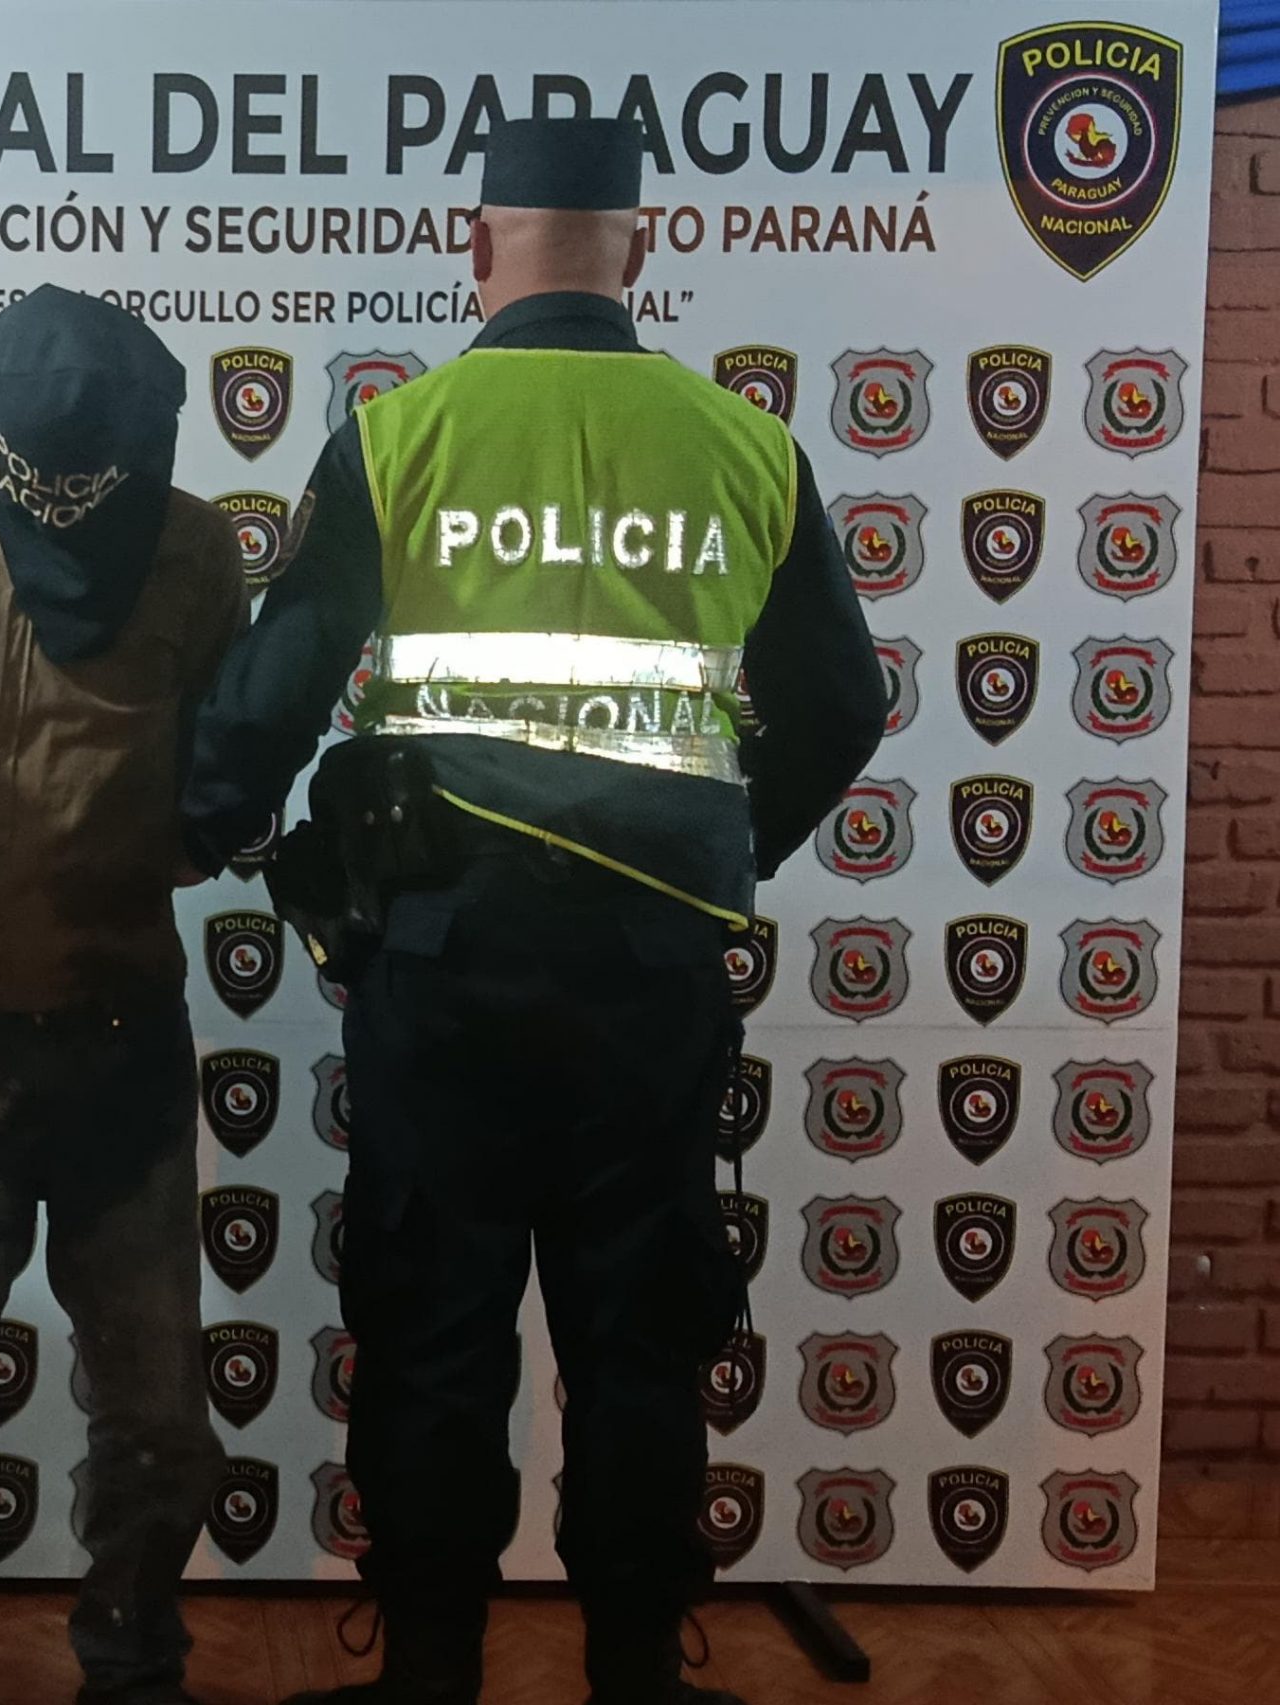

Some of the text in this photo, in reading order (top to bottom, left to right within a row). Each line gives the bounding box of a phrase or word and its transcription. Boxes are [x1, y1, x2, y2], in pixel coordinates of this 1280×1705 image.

[1022, 39, 1163, 82] POLICIA
[1038, 87, 1143, 137] PREVENCION Y SEGURIDAD
[152, 73, 347, 174] DEL
[1051, 177, 1123, 201] PARAGUAY
[141, 206, 170, 252] Y
[185, 206, 472, 255] SEGURIDAD
[723, 190, 936, 252] PARANÁ
[1040, 214, 1133, 235] NACIONAL
[272, 291, 336, 323] SER
[348, 281, 484, 324] POLICÍA
[221, 354, 284, 373] POLICIA
[724, 353, 789, 373] POLICIA
[979, 353, 1042, 372] POLICIA
[972, 497, 1035, 516] POLICIA
[436, 503, 729, 575] POLICIA
[968, 640, 1029, 659] POLICIA
[415, 684, 721, 738] NACIONAL
[962, 781, 1023, 800] POLICIA
[957, 921, 1018, 940] POLICIA
[951, 1062, 1010, 1080] POLICIA
[947, 1200, 1006, 1218] POLICIA
[705, 1471, 754, 1488] OLICIA
